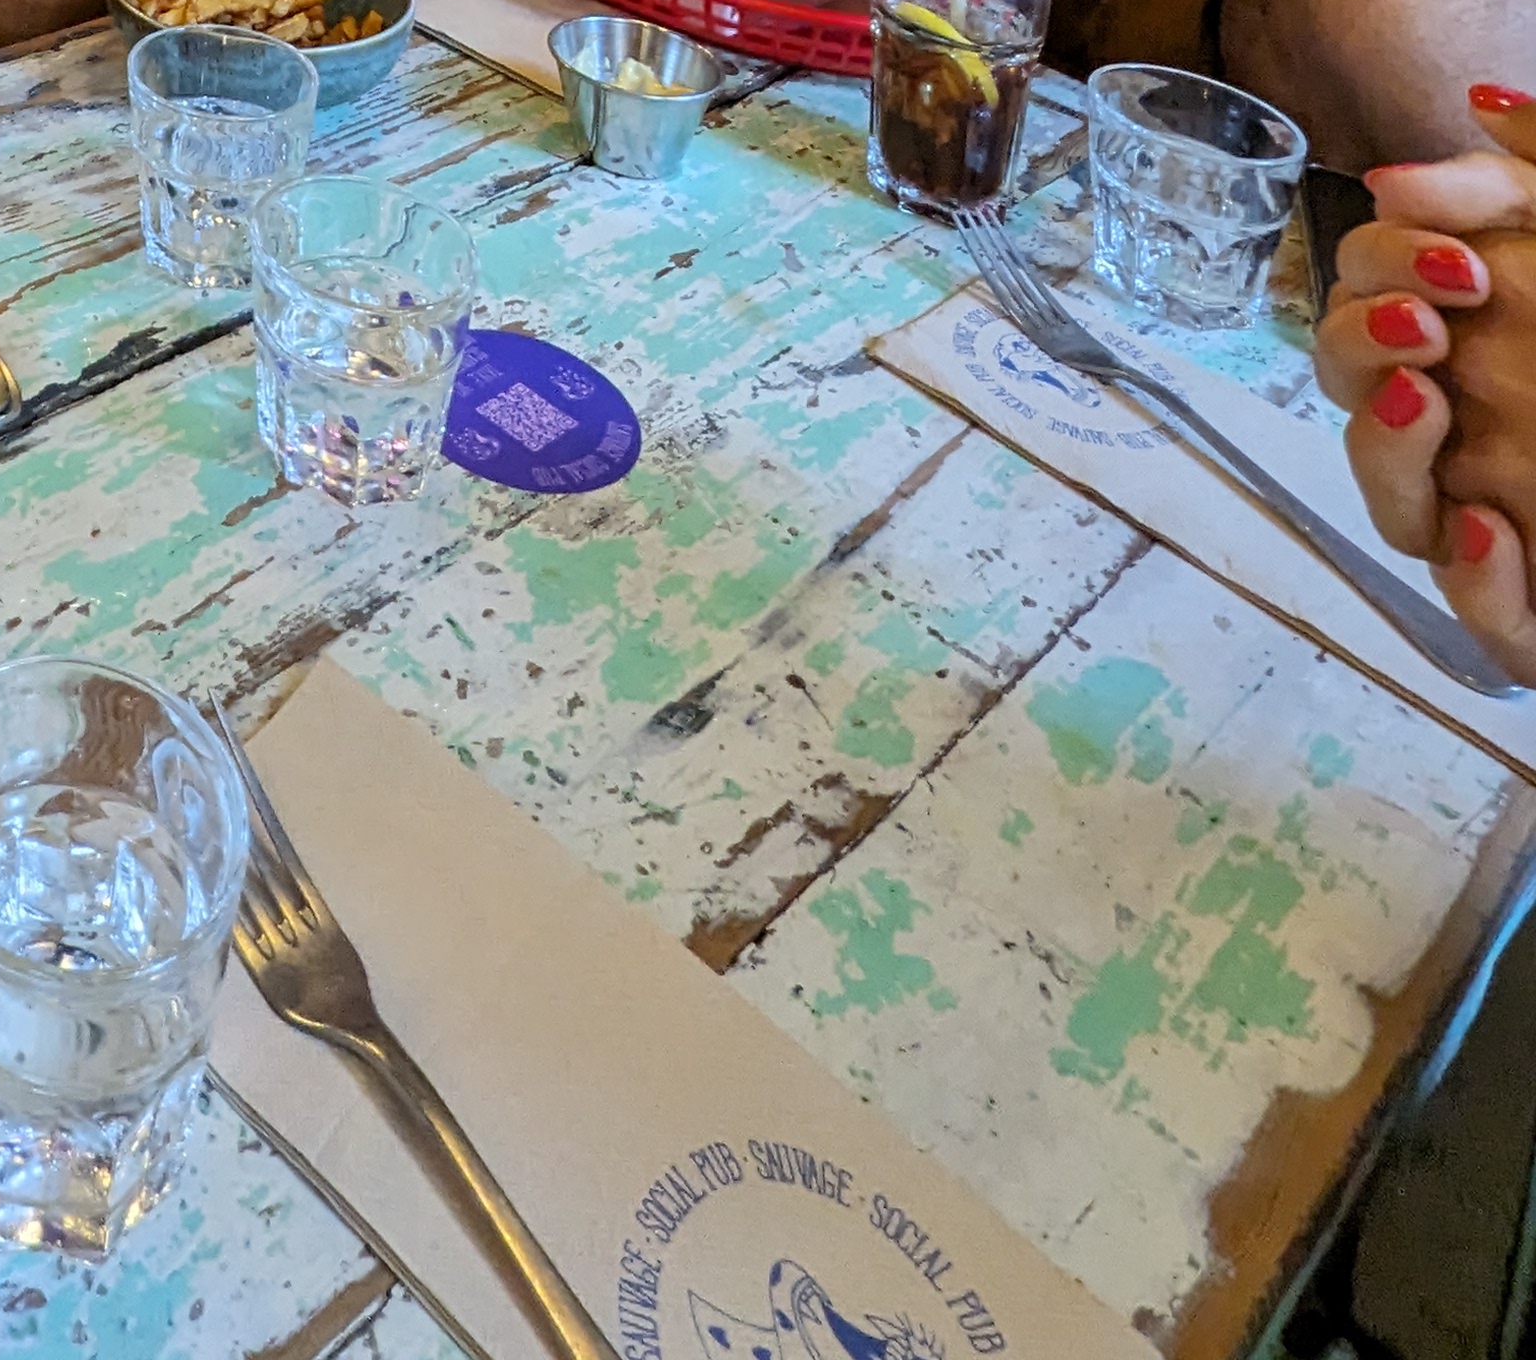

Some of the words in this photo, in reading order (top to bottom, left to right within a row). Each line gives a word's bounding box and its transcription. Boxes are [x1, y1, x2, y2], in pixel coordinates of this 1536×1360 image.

[688, 1142, 744, 1191] PUB
[748, 1138, 854, 1208] SAUVAGE
[634, 1165, 707, 1244] SOCIAL
[869, 1193, 953, 1293] SOCIAL
[617, 1238, 662, 1360] SAUVAGE
[945, 1289, 1006, 1354] PUB
